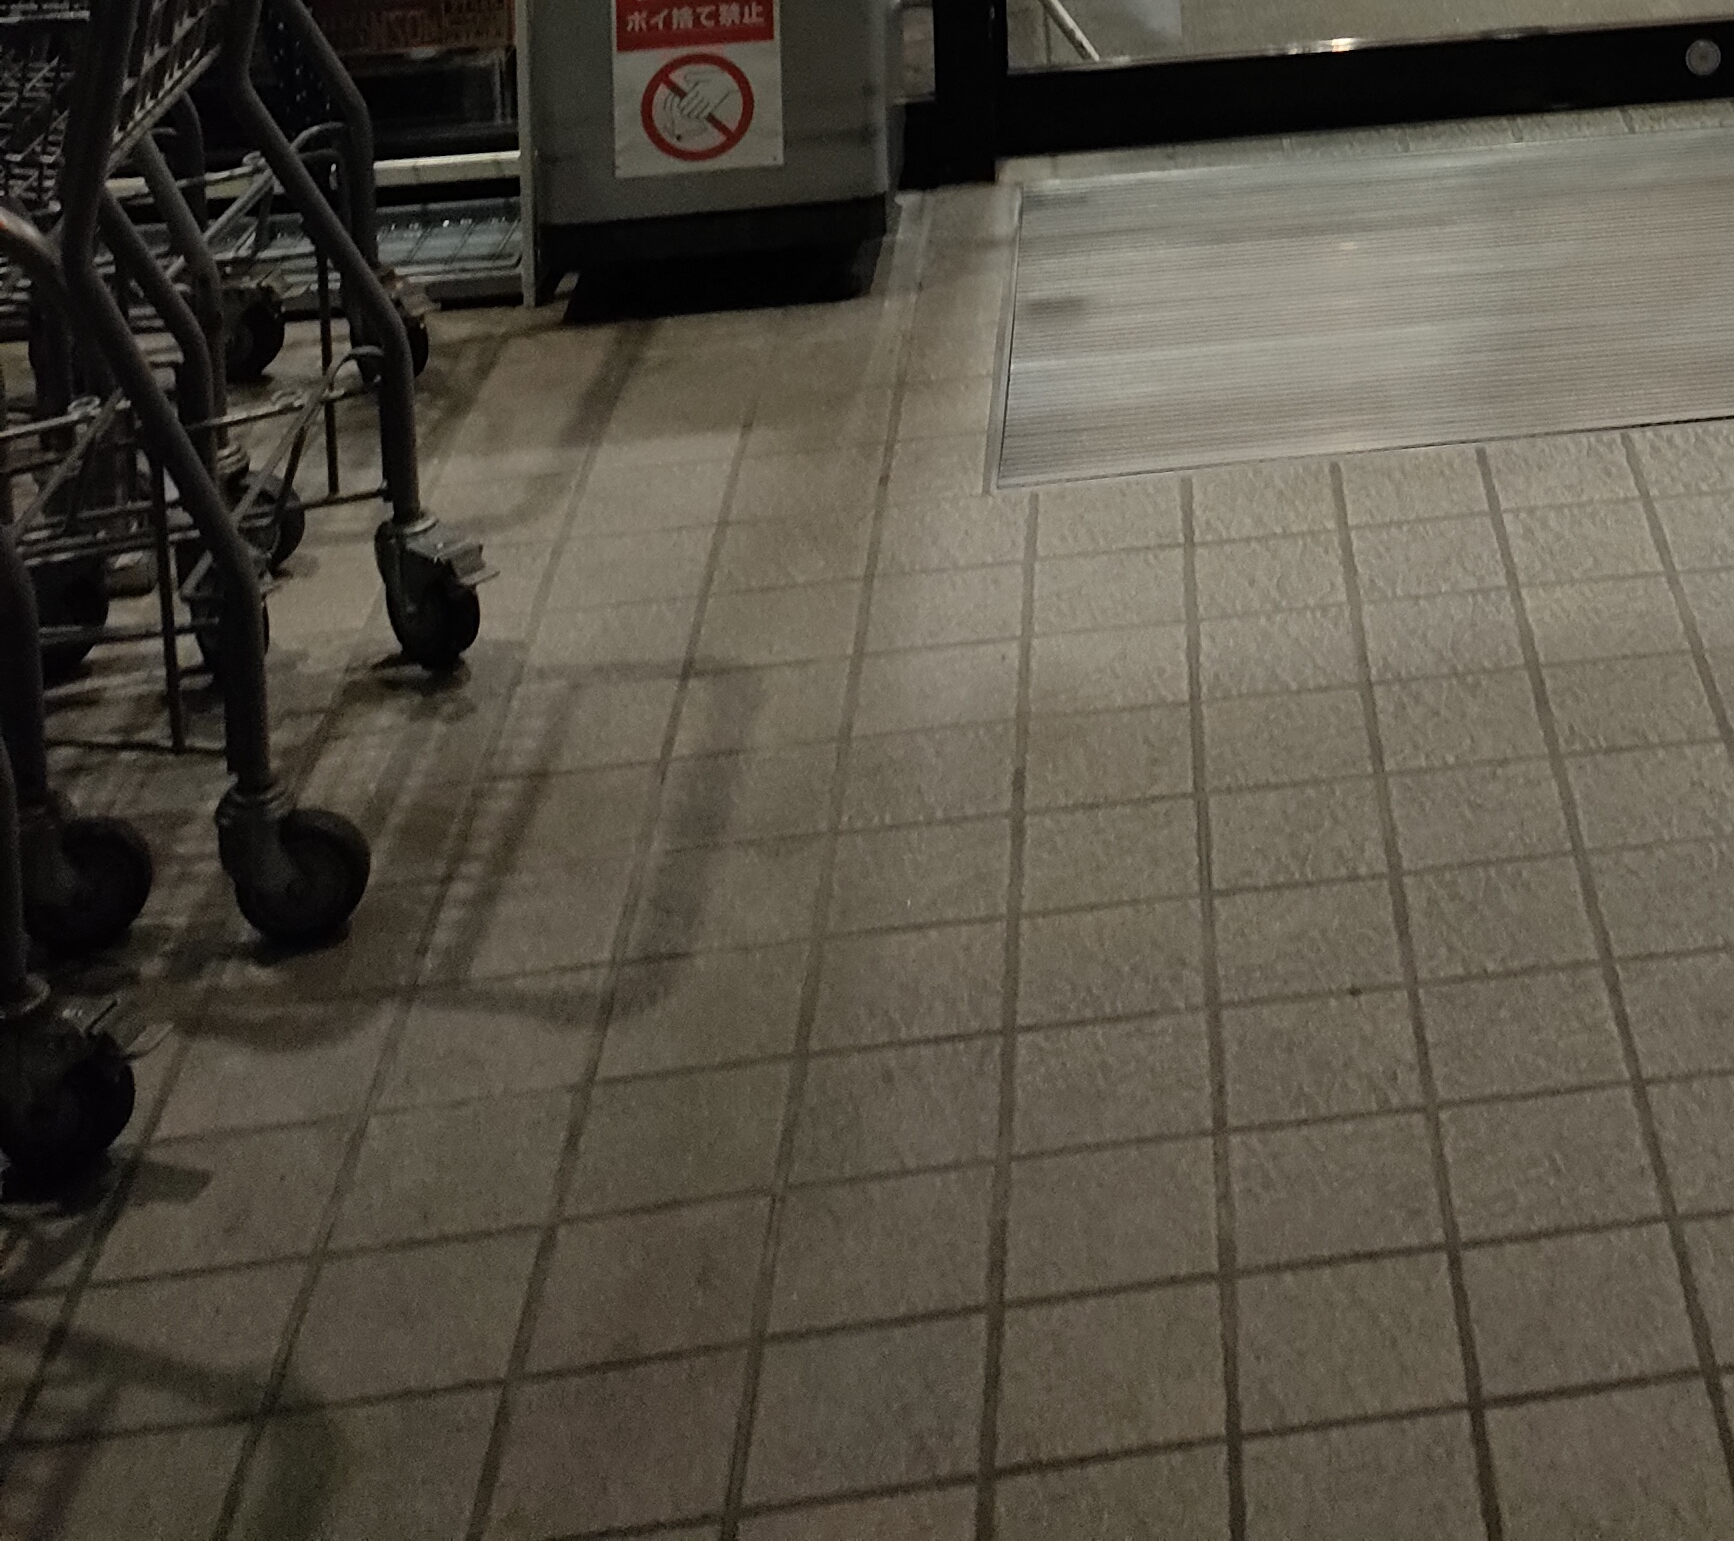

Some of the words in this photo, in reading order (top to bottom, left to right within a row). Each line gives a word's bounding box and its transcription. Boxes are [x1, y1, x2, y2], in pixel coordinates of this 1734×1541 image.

[626, 1, 765, 33] ポイ捨て禁止
